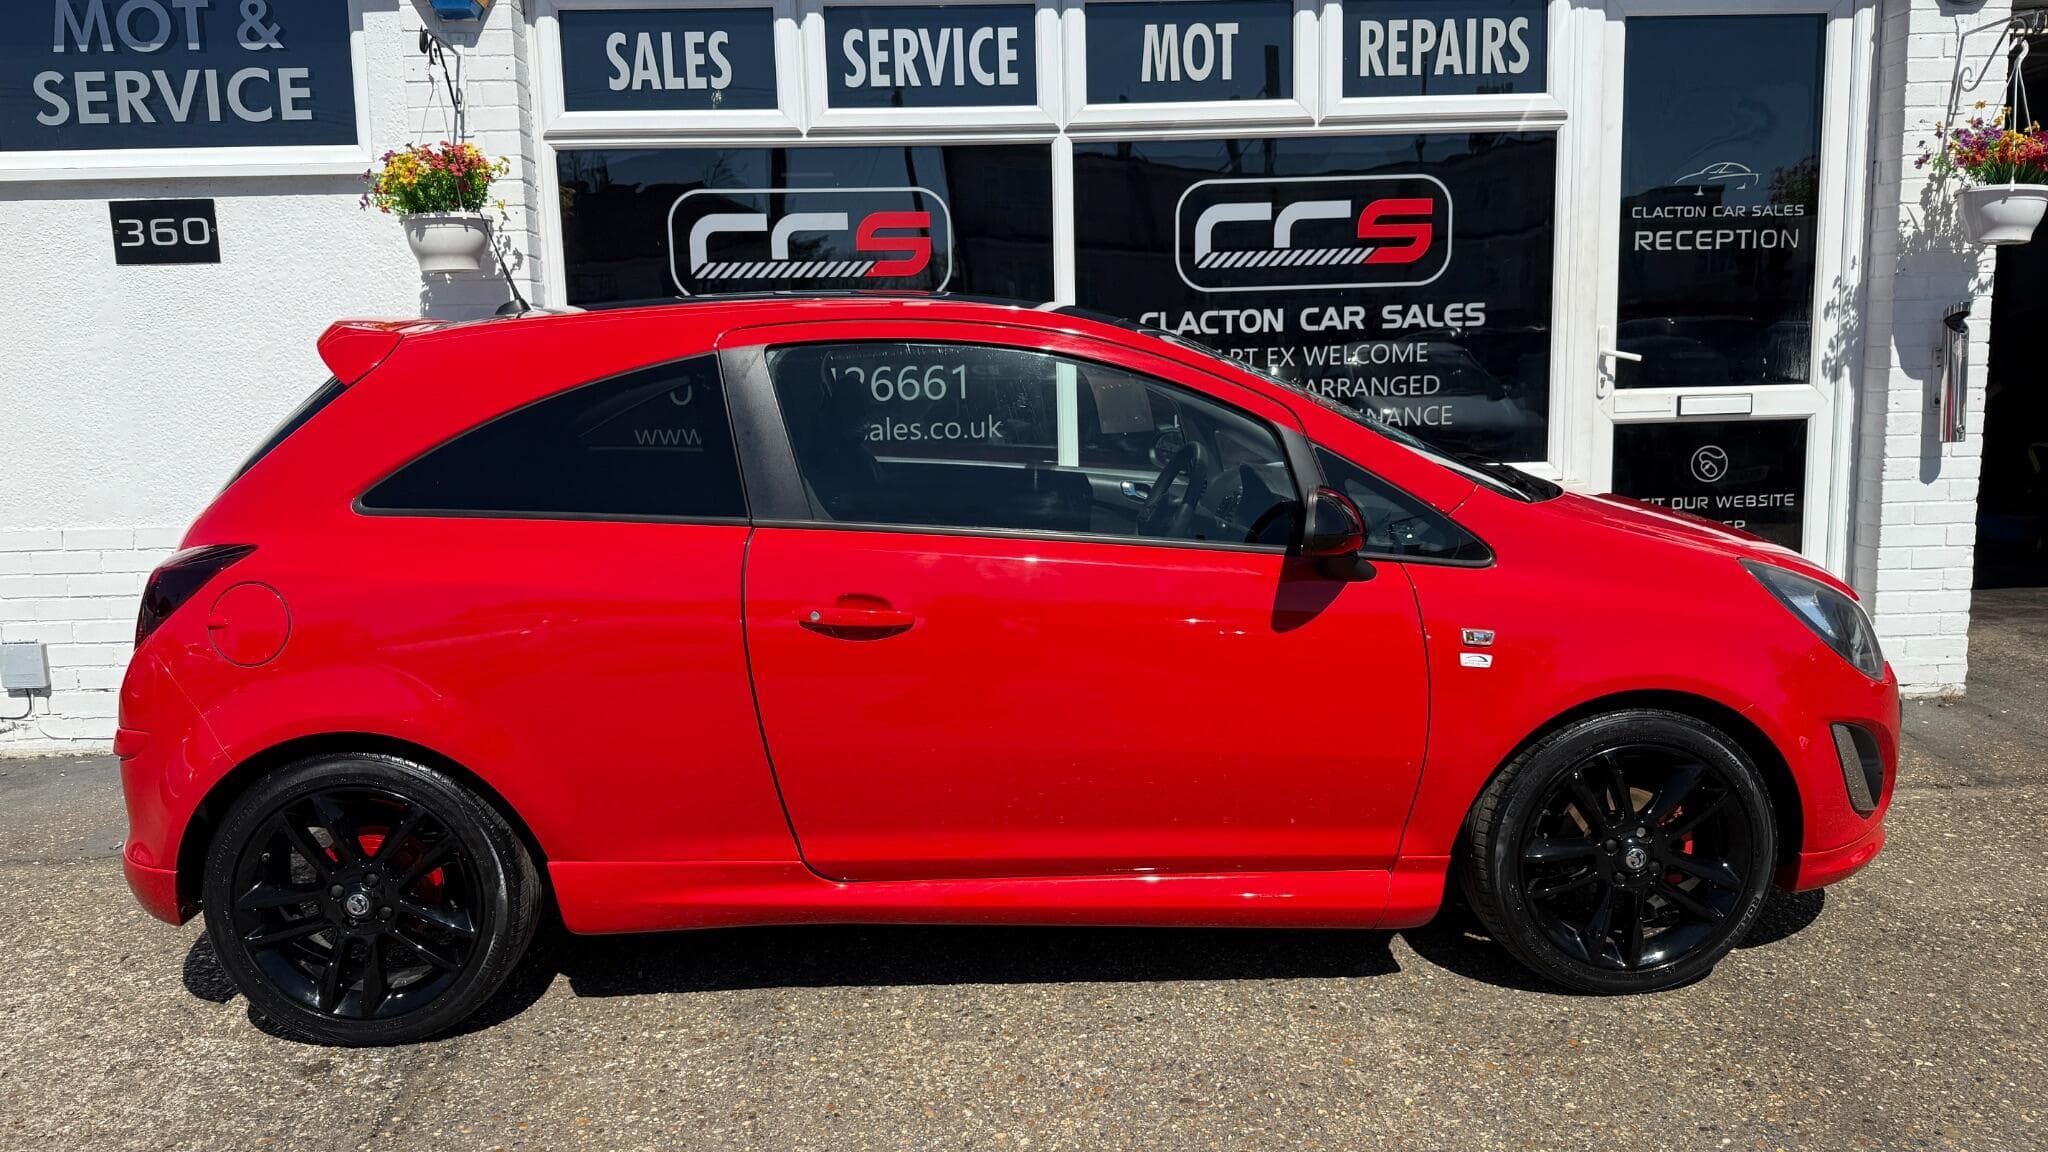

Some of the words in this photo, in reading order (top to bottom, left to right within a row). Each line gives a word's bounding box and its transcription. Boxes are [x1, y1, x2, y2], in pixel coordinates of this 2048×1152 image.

[53, 0, 209, 52] MOT
[237, 0, 284, 50] &
[606, 31, 732, 90] SALES
[842, 27, 1019, 88] SERVICE
[1141, 23, 1239, 82] MOT
[1360, 17, 1529, 77] REPAIRS
[32, 67, 313, 126] SERVICE
[1632, 205, 1707, 219] CLACTON
[1712, 205, 1746, 217] CAR
[1751, 204, 1805, 217] SALES
[118, 217, 210, 247] 360
[1634, 228, 1799, 251] RECEPTION
[1139, 308, 1284, 335] CLACTON
[1300, 306, 1366, 331] CAR
[1381, 302, 1486, 329] SALES
[1267, 346, 1296, 368] EX
[1302, 342, 1428, 366] WELCOME
[1304, 375, 1441, 398] ARRANGED
[864, 414, 1003, 441] ales.co.uk
[1671, 496, 1709, 510] OUR
[1715, 493, 1795, 508] WEBSITE
